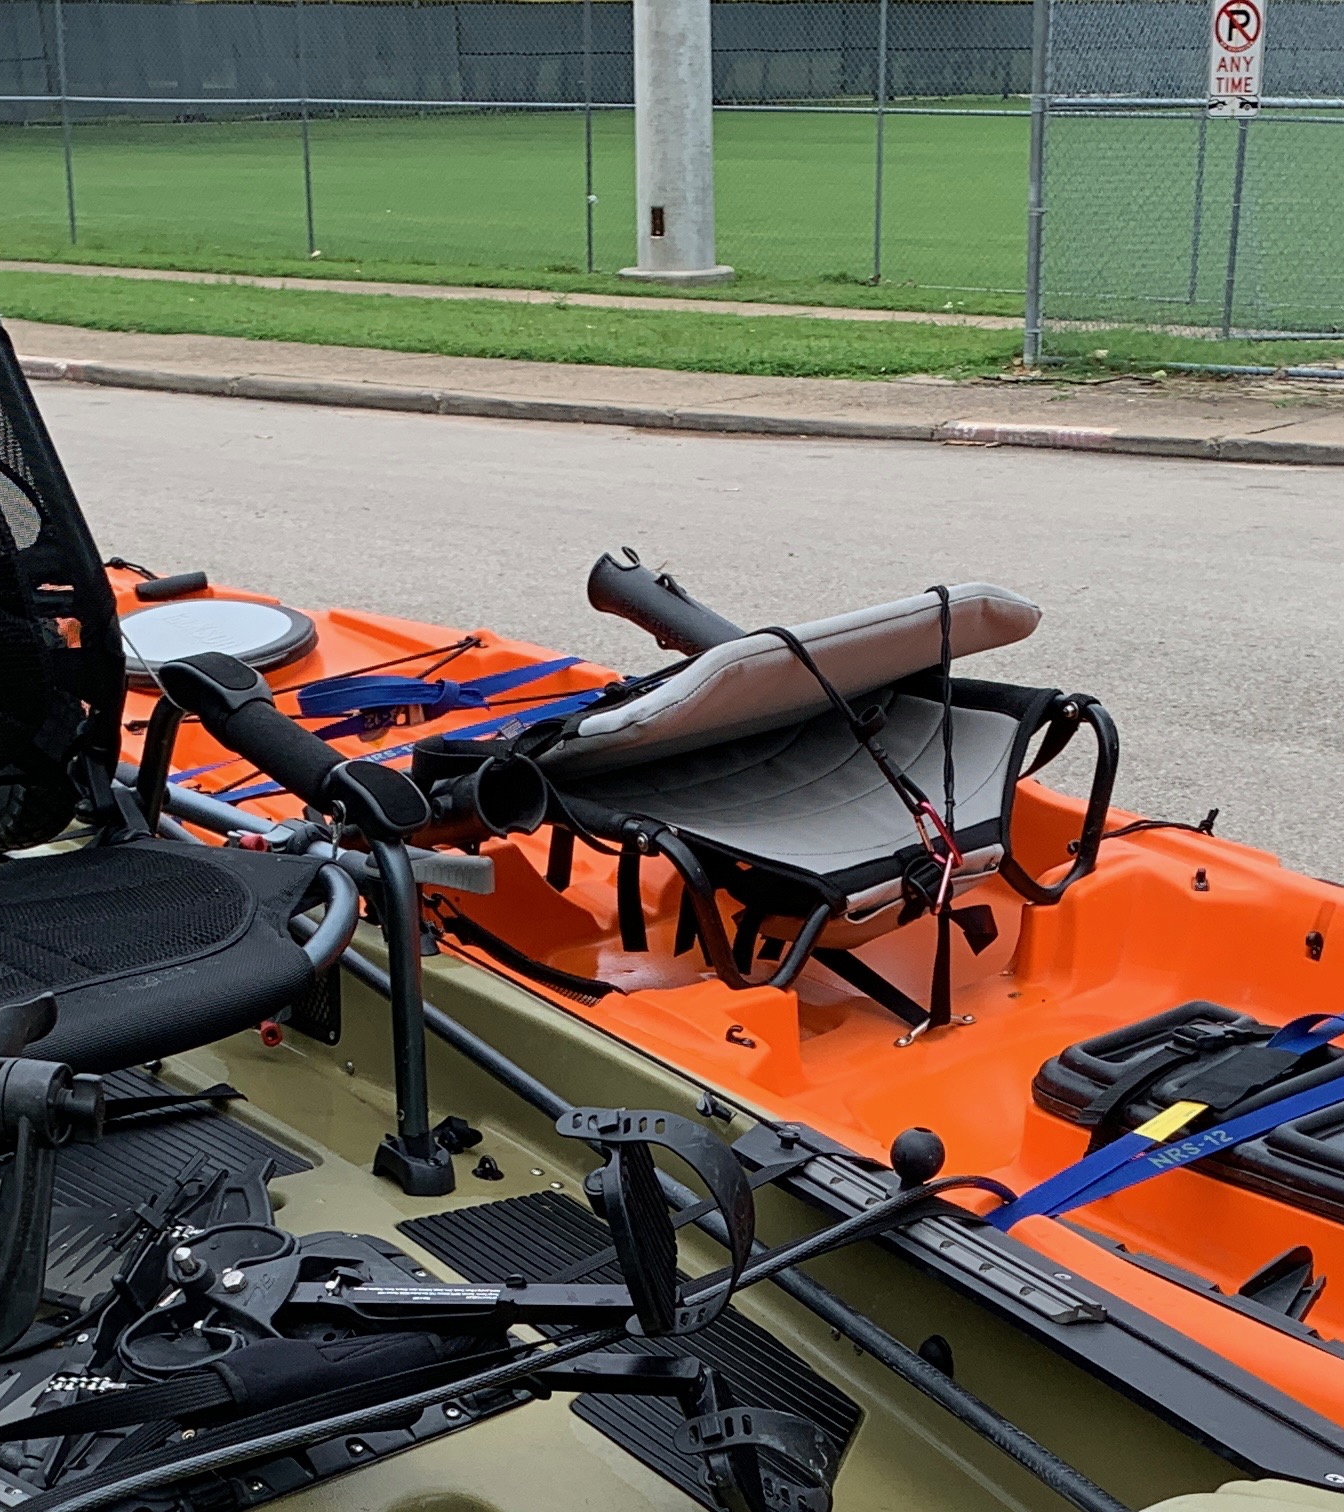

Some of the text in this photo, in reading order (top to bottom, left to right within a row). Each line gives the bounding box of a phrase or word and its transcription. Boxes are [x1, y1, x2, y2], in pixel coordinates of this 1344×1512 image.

[1216, 56, 1255, 73] ANY
[1216, 76, 1254, 94] TIME
[1147, 1129, 1234, 1169] NRS-12
